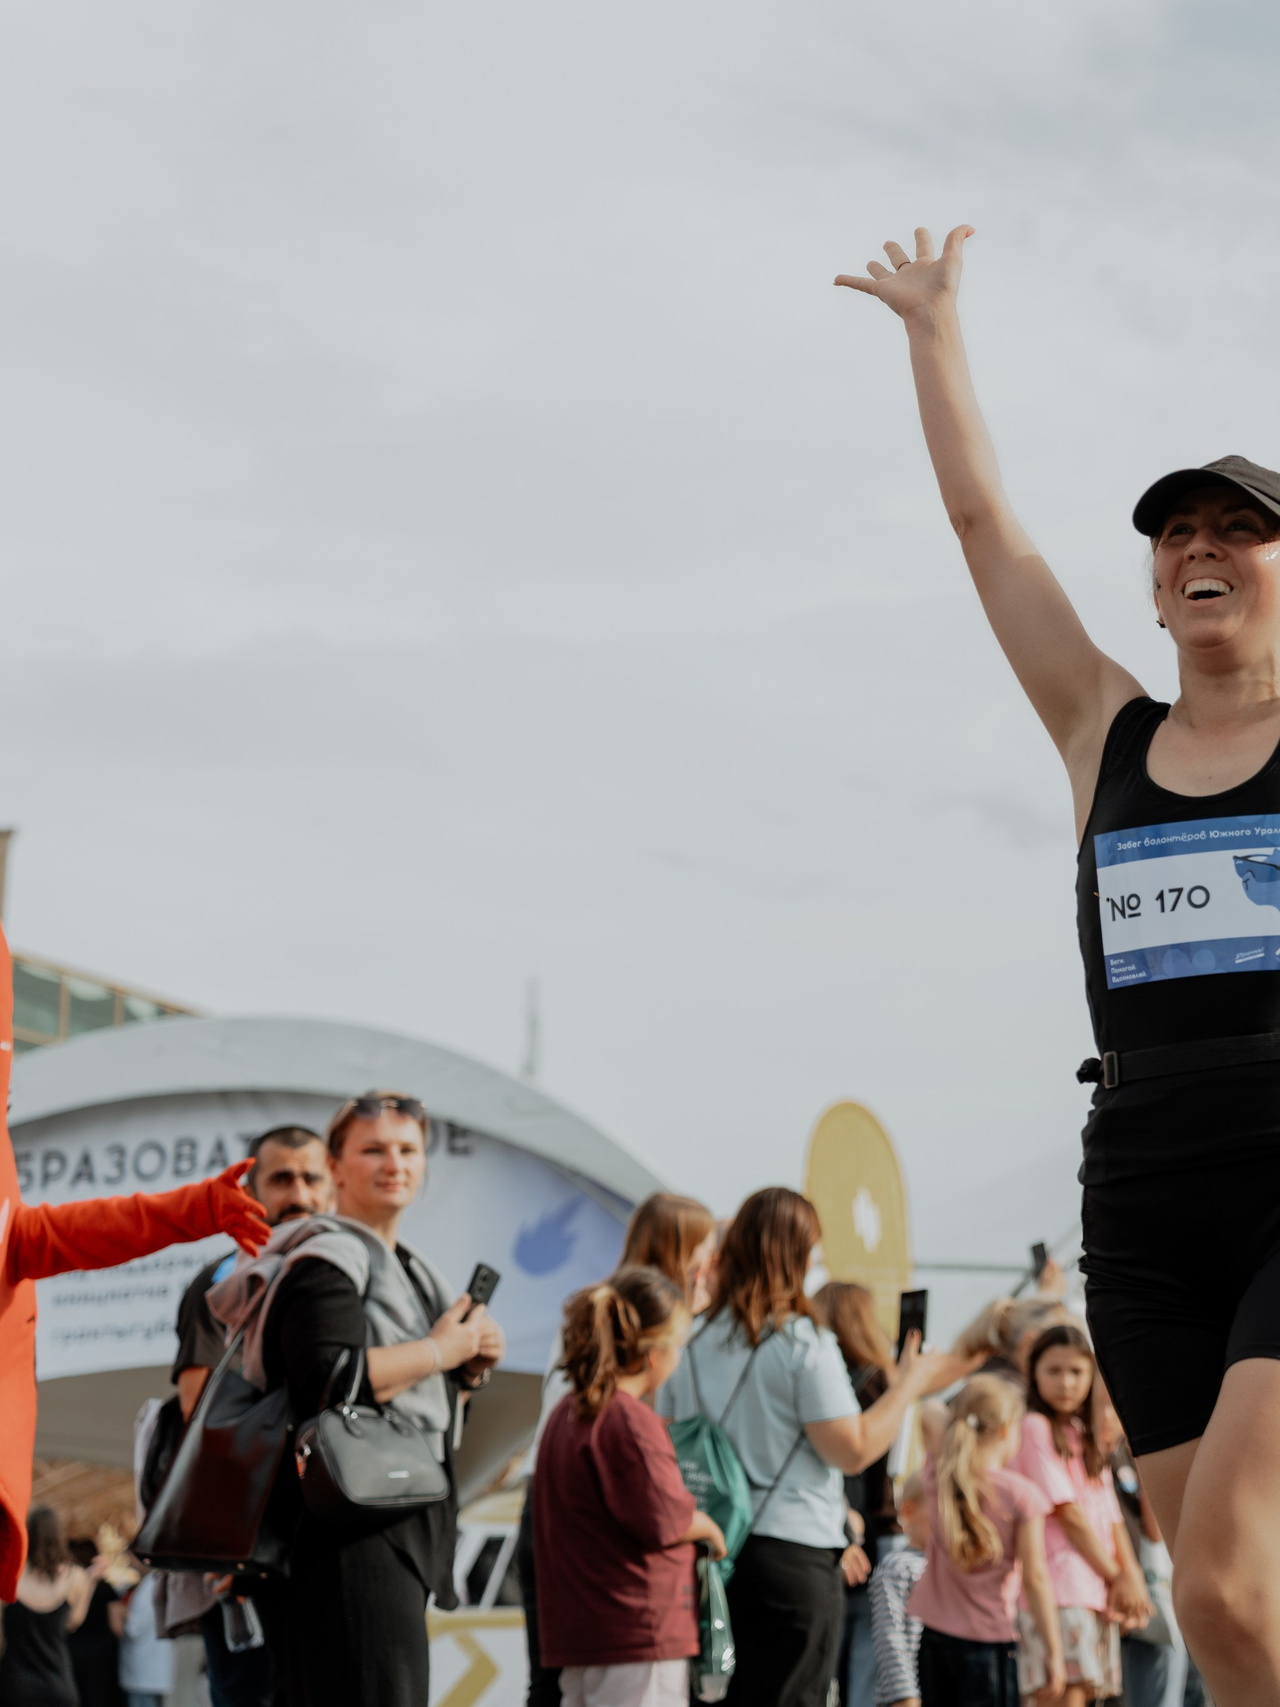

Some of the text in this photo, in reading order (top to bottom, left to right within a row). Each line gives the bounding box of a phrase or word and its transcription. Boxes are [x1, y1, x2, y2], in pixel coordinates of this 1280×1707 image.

[1117, 840, 1142, 851] Забег
[1143, 830, 1207, 847] волонтёров
[1209, 829, 1252, 839] Южного
[1110, 885, 1210, 922] № 170
